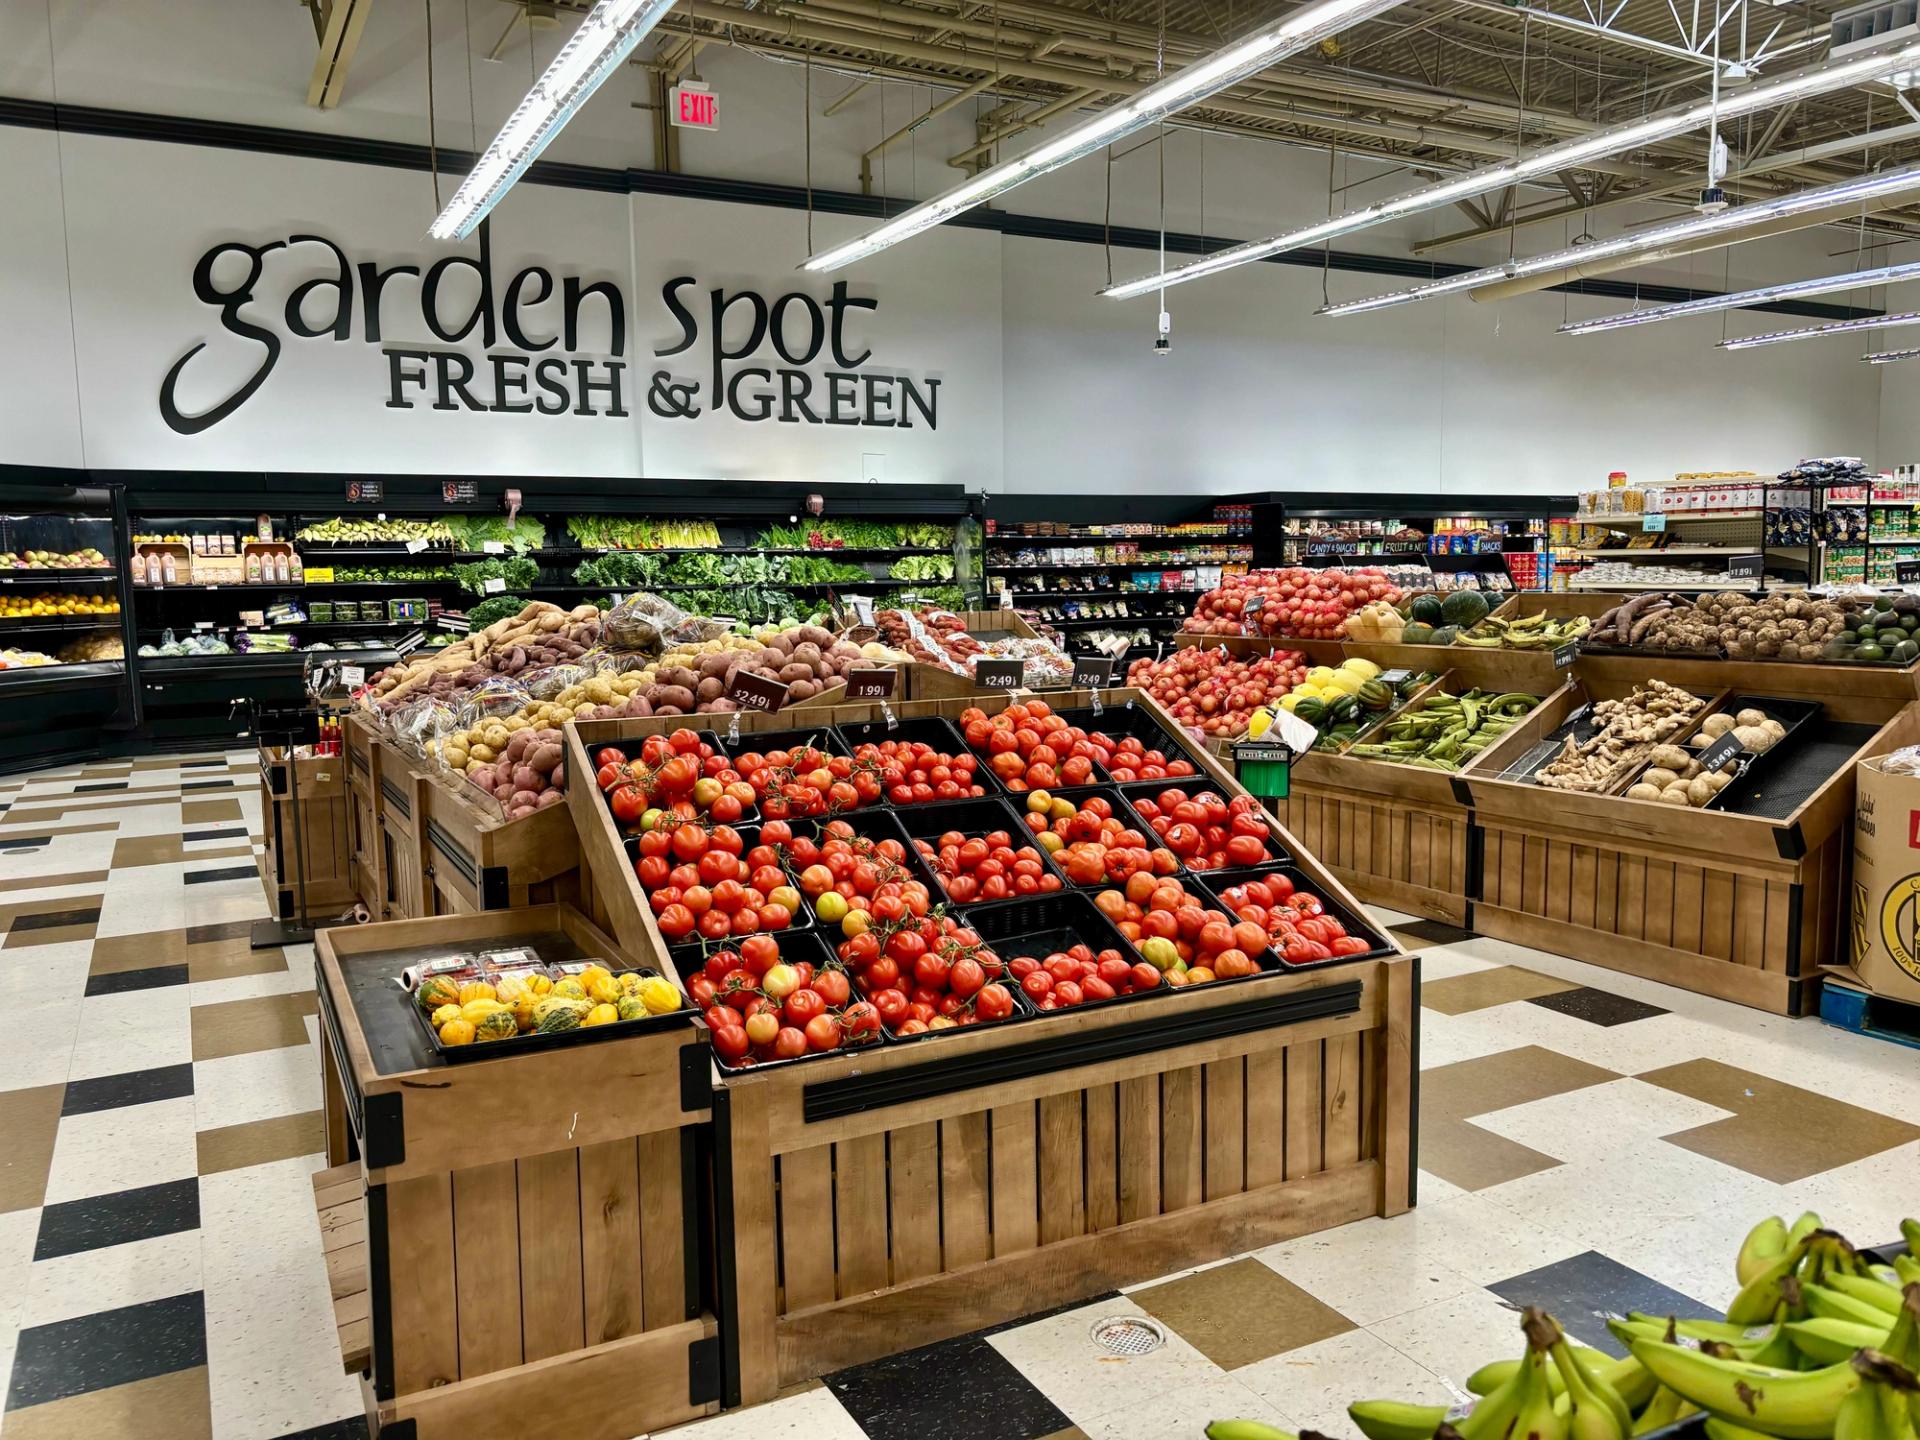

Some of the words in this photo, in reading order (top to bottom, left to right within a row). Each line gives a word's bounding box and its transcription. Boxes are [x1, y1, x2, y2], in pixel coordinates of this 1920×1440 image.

[680, 92, 714, 126] EXIT
[159, 214, 625, 434] garden
[655, 276, 878, 411] spot
[382, 348, 628, 418] FRESH
[648, 370, 701, 419] &
[727, 368, 942, 431] GREEN
[1310, 543, 1330, 553] CANDY
[1336, 543, 1357, 553] SNACKS
[1385, 542, 1407, 552] FRUIT
[1480, 542, 1501, 551] SNACKS
[985, 675, 1012, 686] $2.49
[735, 689, 767, 707] $2.49
